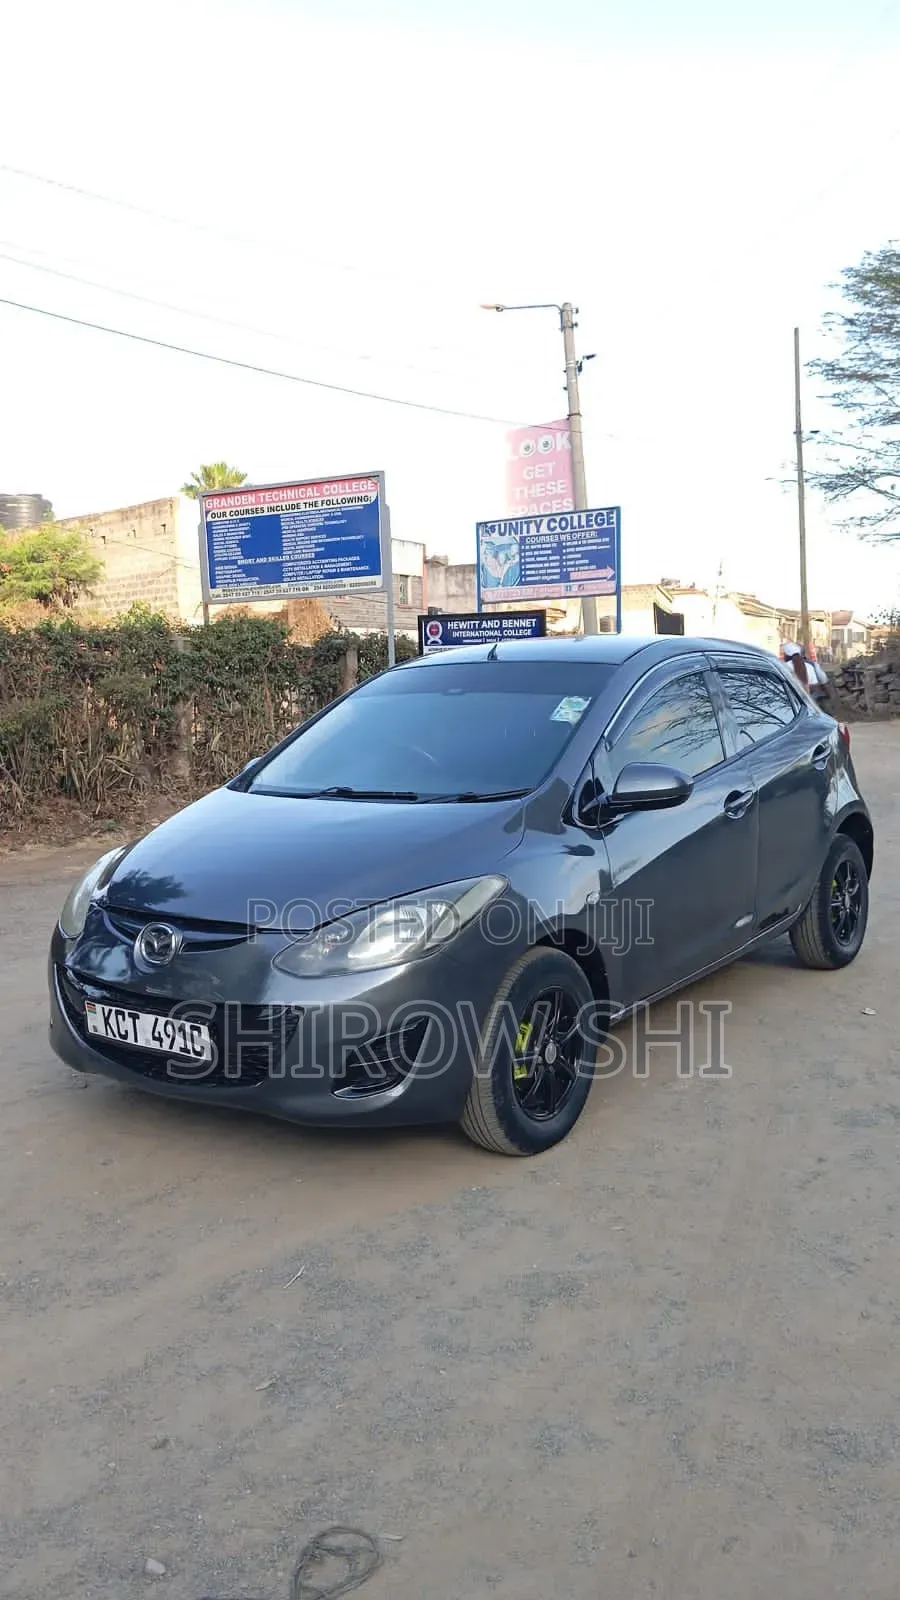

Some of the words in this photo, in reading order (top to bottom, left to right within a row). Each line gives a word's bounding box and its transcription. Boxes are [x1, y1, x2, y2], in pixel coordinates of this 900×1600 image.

[508, 432, 572, 460] LOOK
[523, 462, 556, 480] GET
[206, 494, 256, 509] GRANDEN
[258, 488, 320, 502] TECHNICAL
[322, 481, 375, 495] COLLEGE
[512, 480, 567, 499] THESE
[210, 510, 226, 519] OUR
[229, 506, 264, 516] COURSES
[267, 502, 300, 512] INCLUDE
[302, 500, 319, 508] THE
[498, 519, 544, 536] UNITY
[547, 511, 614, 532] COLLEGE
[526, 535, 558, 543] COURSES
[448, 620, 479, 629] HEWITT
[482, 620, 499, 628] AND
[503, 619, 536, 627] BENNET
[452, 629, 501, 638] INTERNATIONAL
[101, 1007, 140, 1043] KCT
[152, 1018, 205, 1057] 491C
